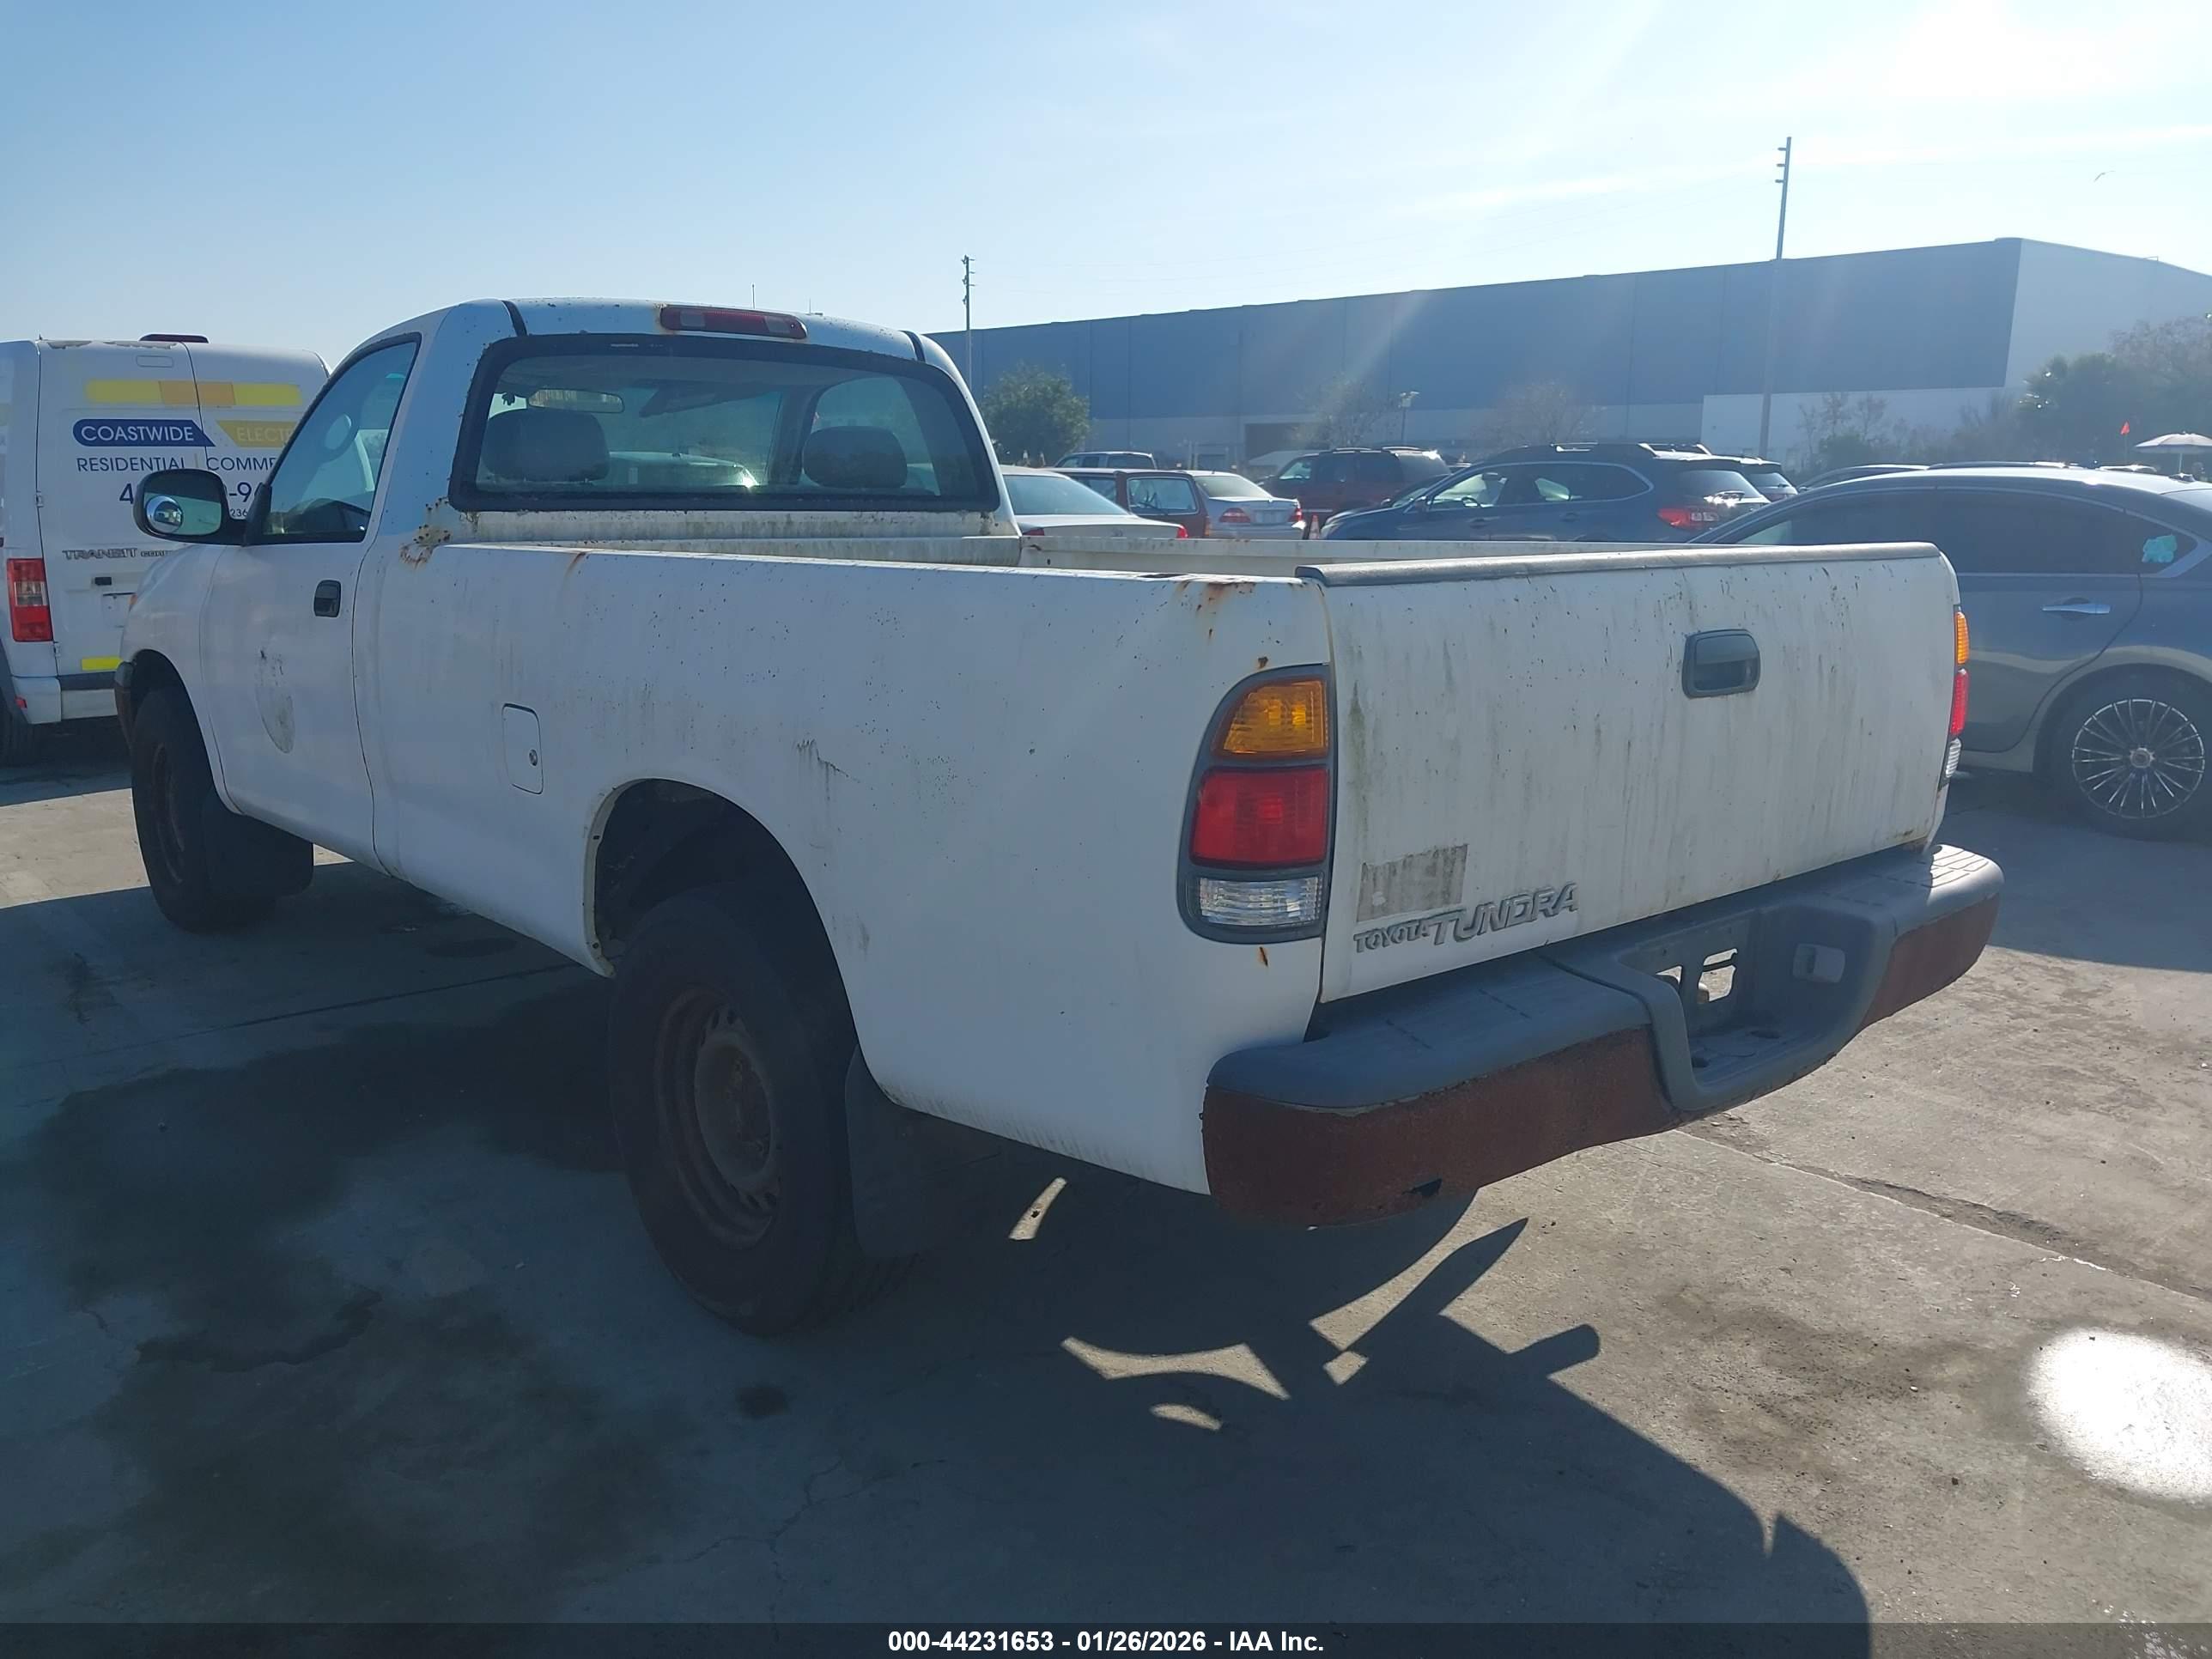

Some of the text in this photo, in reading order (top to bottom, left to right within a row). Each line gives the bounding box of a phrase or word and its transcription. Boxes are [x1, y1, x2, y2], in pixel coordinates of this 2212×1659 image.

[81, 426, 194, 441] COASTWIDE
[76, 457, 185, 471] RESIDENTIAL
[62, 547, 137, 560] TRANSIT
[1353, 882, 1578, 953] TOYOTA TUNDRA
